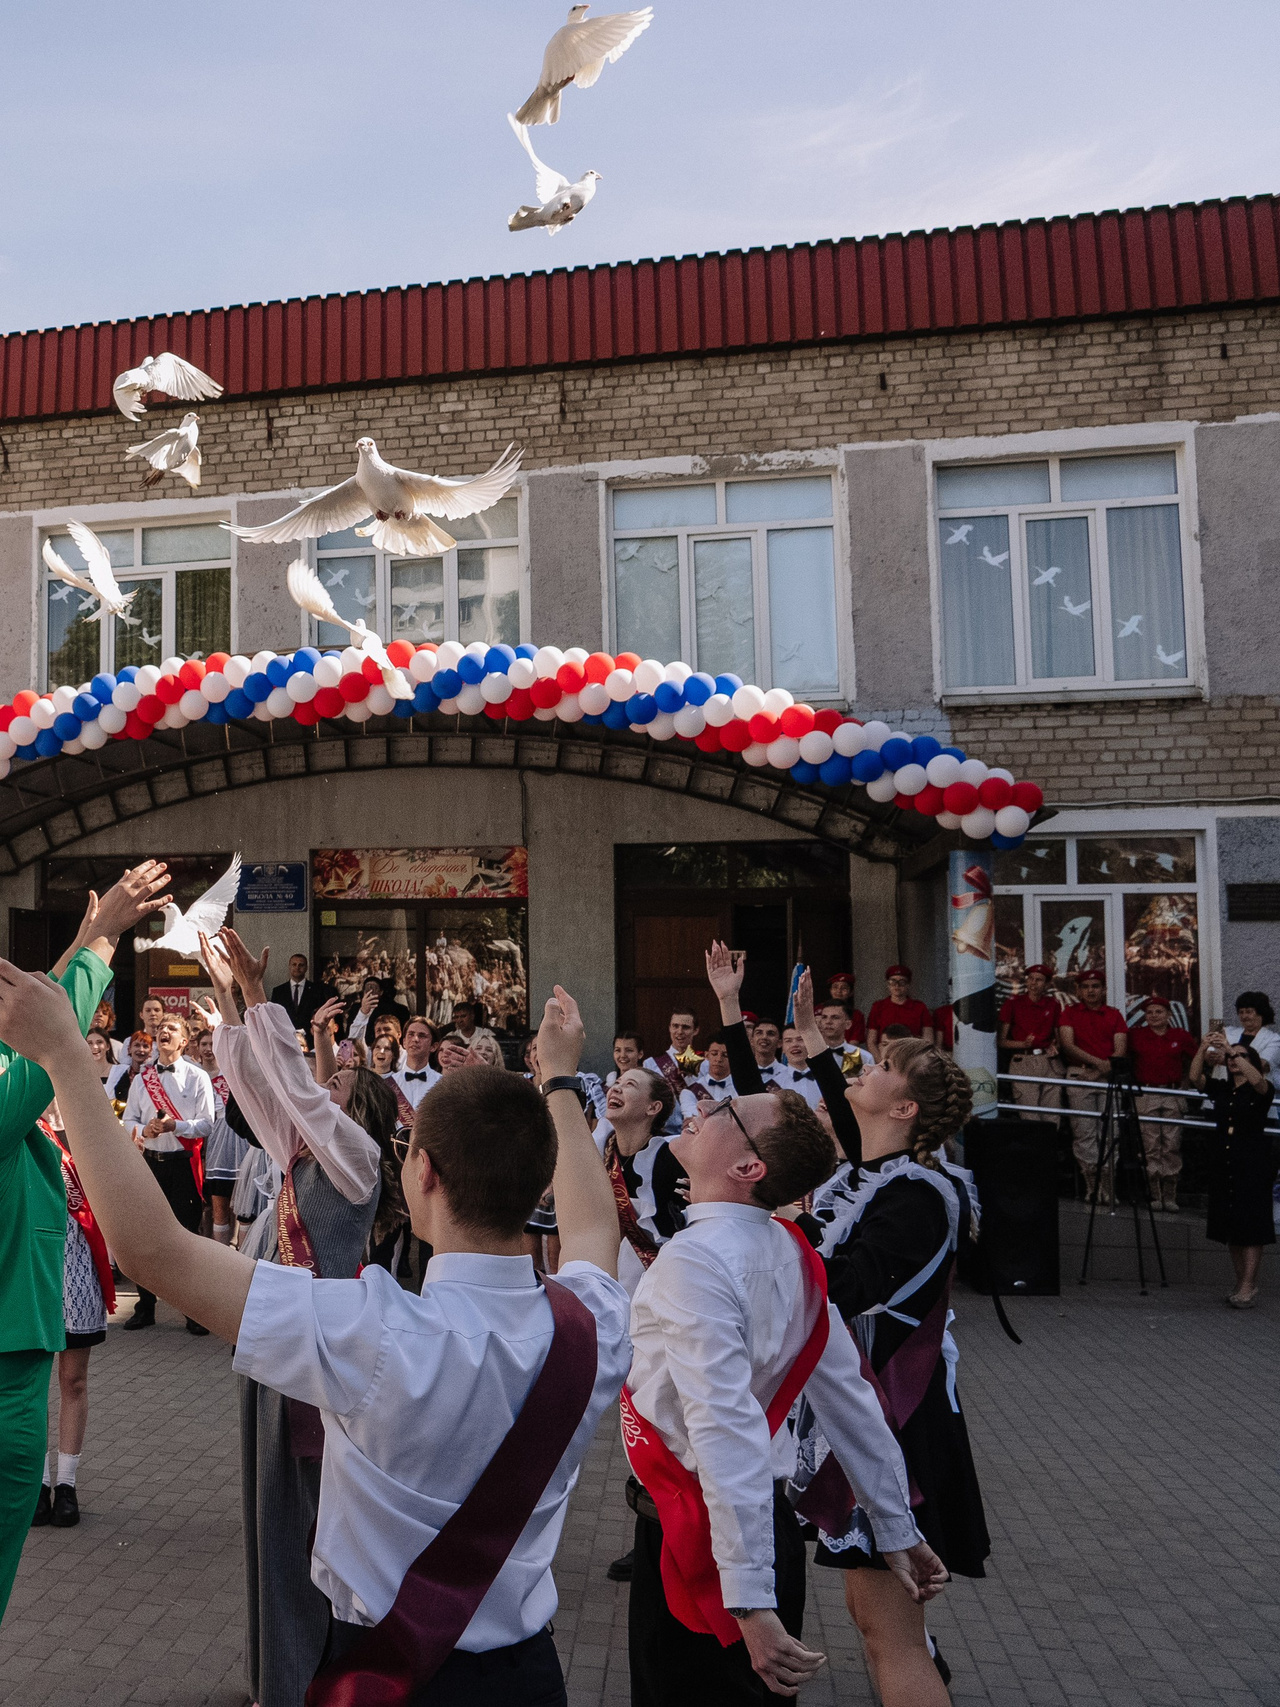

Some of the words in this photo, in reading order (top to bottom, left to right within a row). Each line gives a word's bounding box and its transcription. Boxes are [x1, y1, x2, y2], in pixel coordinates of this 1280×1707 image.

[371, 858, 400, 874] До
[371, 879, 424, 893] ШКОЛА!
[161, 996, 188, 1007] ХОД
[620, 1402, 649, 1447] 2025
